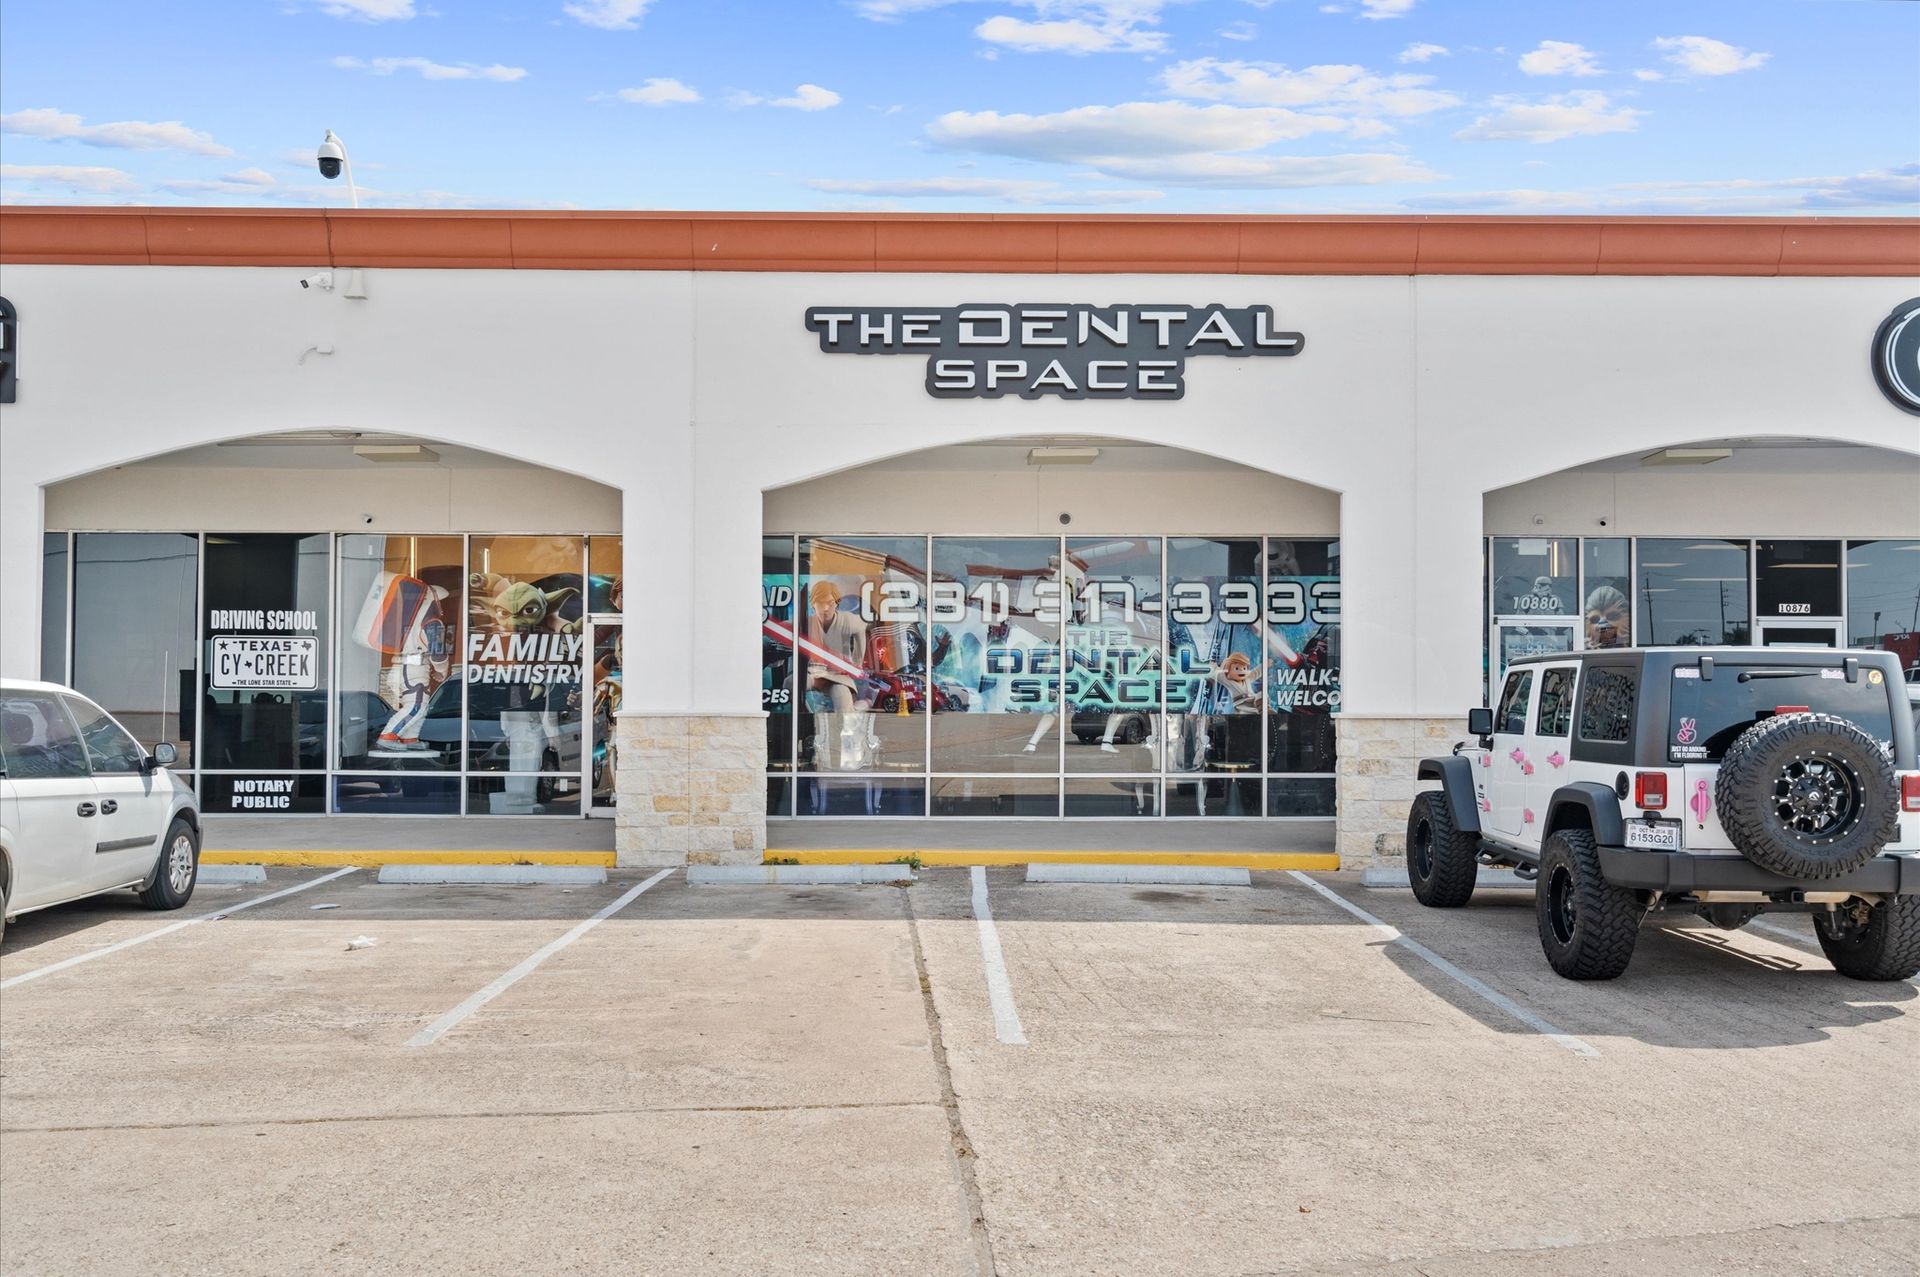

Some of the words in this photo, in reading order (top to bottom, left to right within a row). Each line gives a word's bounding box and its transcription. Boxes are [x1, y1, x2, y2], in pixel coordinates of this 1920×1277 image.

[813, 313, 941, 344] THE
[958, 310, 1298, 347] DENTAL
[934, 359, 1178, 390] SPACE
[860, 581, 1009, 622] (281)
[1513, 596, 1559, 610] 10880
[1779, 603, 1811, 613] 10876
[211, 610, 265, 629] DRIVING
[266, 610, 318, 630] SCHOOL
[239, 641, 292, 651] TEXAS
[468, 633, 583, 662] FAMILY
[1067, 630, 1129, 646] THE
[221, 653, 242, 676] CY
[255, 654, 309, 676] CREEK
[986, 648, 1212, 675] DENTAL
[467, 664, 583, 684] DENTISTRY
[1010, 679, 1187, 703] SPACE
[233, 780, 295, 793] NOTARY
[231, 795, 290, 808] PUBLIC
[1631, 833, 1673, 843] 6153G20
